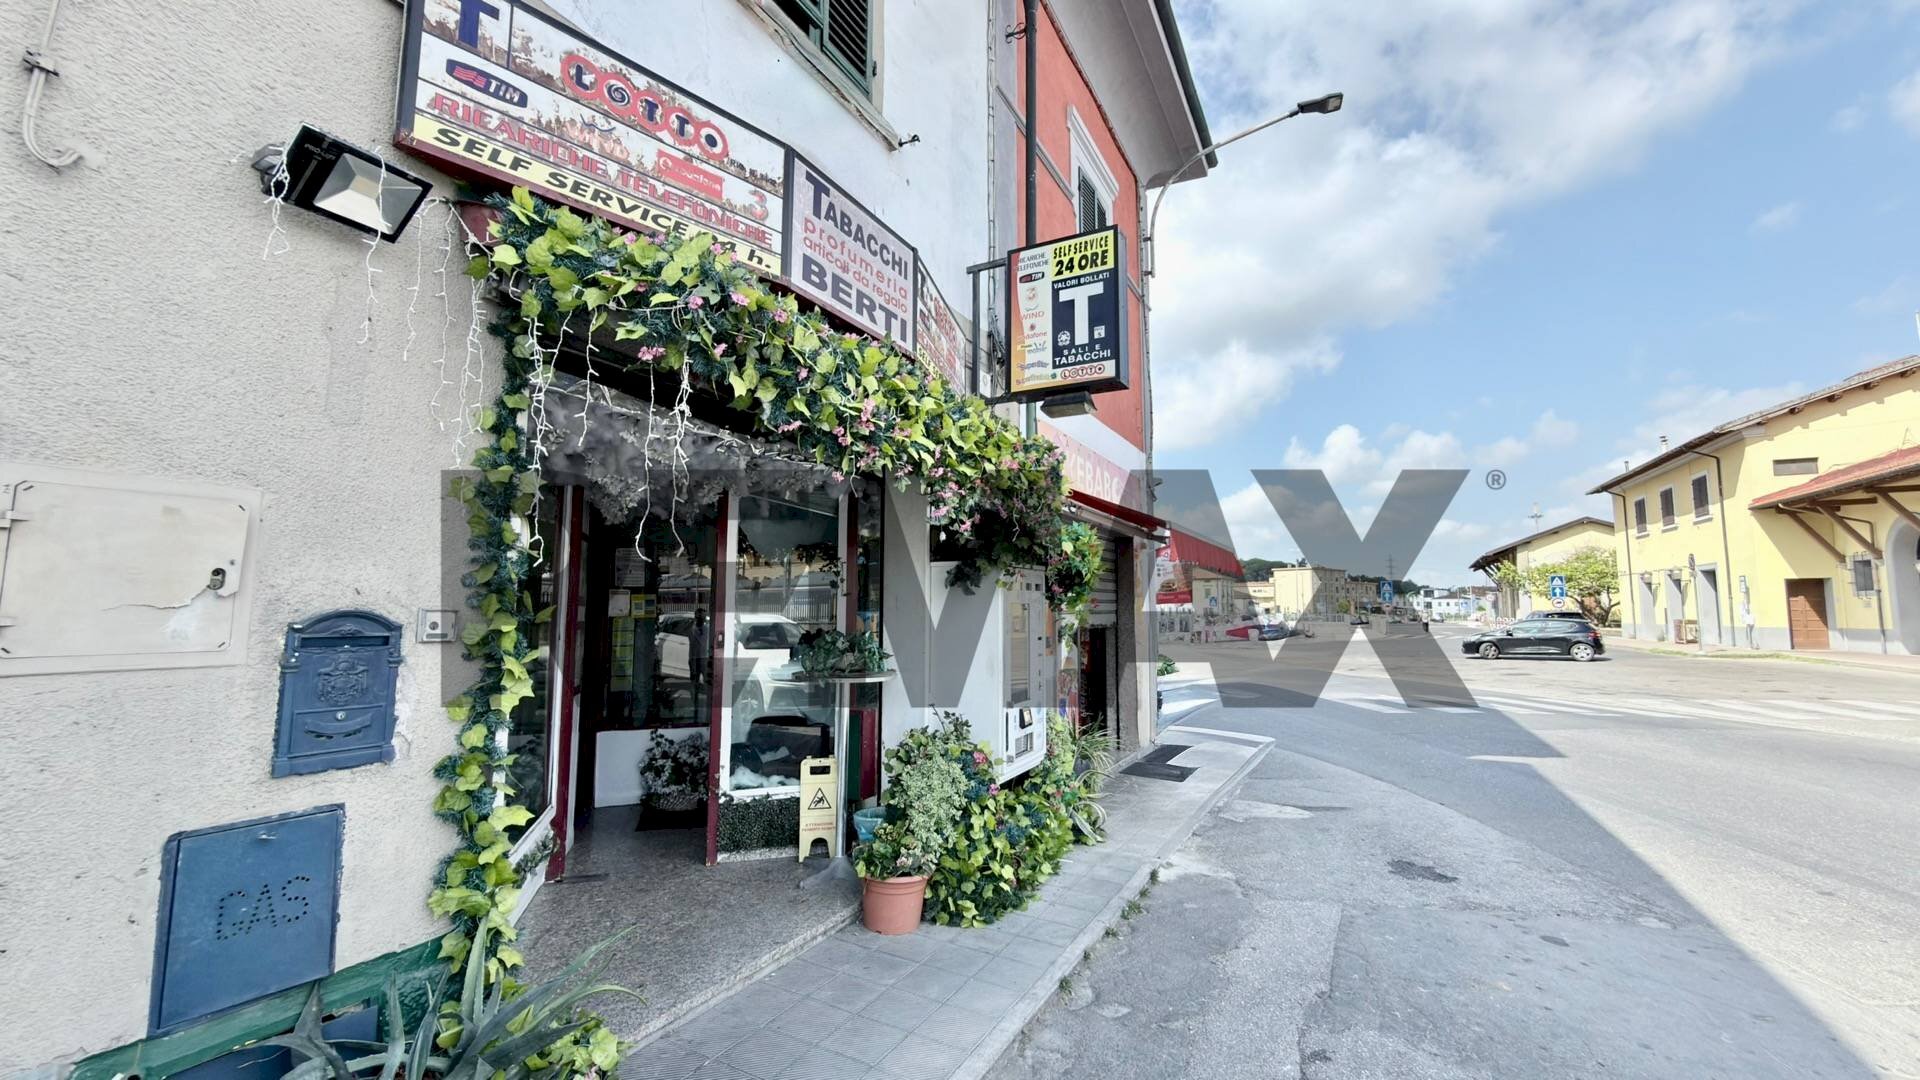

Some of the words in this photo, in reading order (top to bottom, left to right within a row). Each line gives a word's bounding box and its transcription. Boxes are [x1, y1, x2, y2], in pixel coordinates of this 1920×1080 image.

[458, 0, 499, 48] T
[488, 77, 520, 104] TIM
[568, 58, 724, 156] LOTTO
[430, 93, 608, 178] RICARICHE
[618, 169, 773, 249] TELEFONICHE
[433, 127, 532, 172] SELF
[543, 171, 689, 238] SERVICE
[747, 248, 772, 269] h.
[749, 189, 768, 220] 3
[805, 169, 908, 281] TABACCHI
[1053, 244, 1072, 259] SELF
[1073, 235, 1109, 255] SERVICE
[803, 217, 908, 300] profumeria
[803, 236, 850, 275] articoli
[852, 269, 870, 288] da
[872, 283, 908, 314] regalo
[1053, 278, 1079, 289] VALORI
[1080, 272, 1110, 285] BOLLATI
[1054, 257, 1075, 277] 24
[1077, 249, 1109, 271] ORE
[802, 252, 907, 344] BERTI
[1053, 350, 1111, 366] TABACCHI
[1062, 364, 1104, 379] LOTTO
[1063, 345, 1089, 356] SALI
[216, 875, 311, 941] GAS
